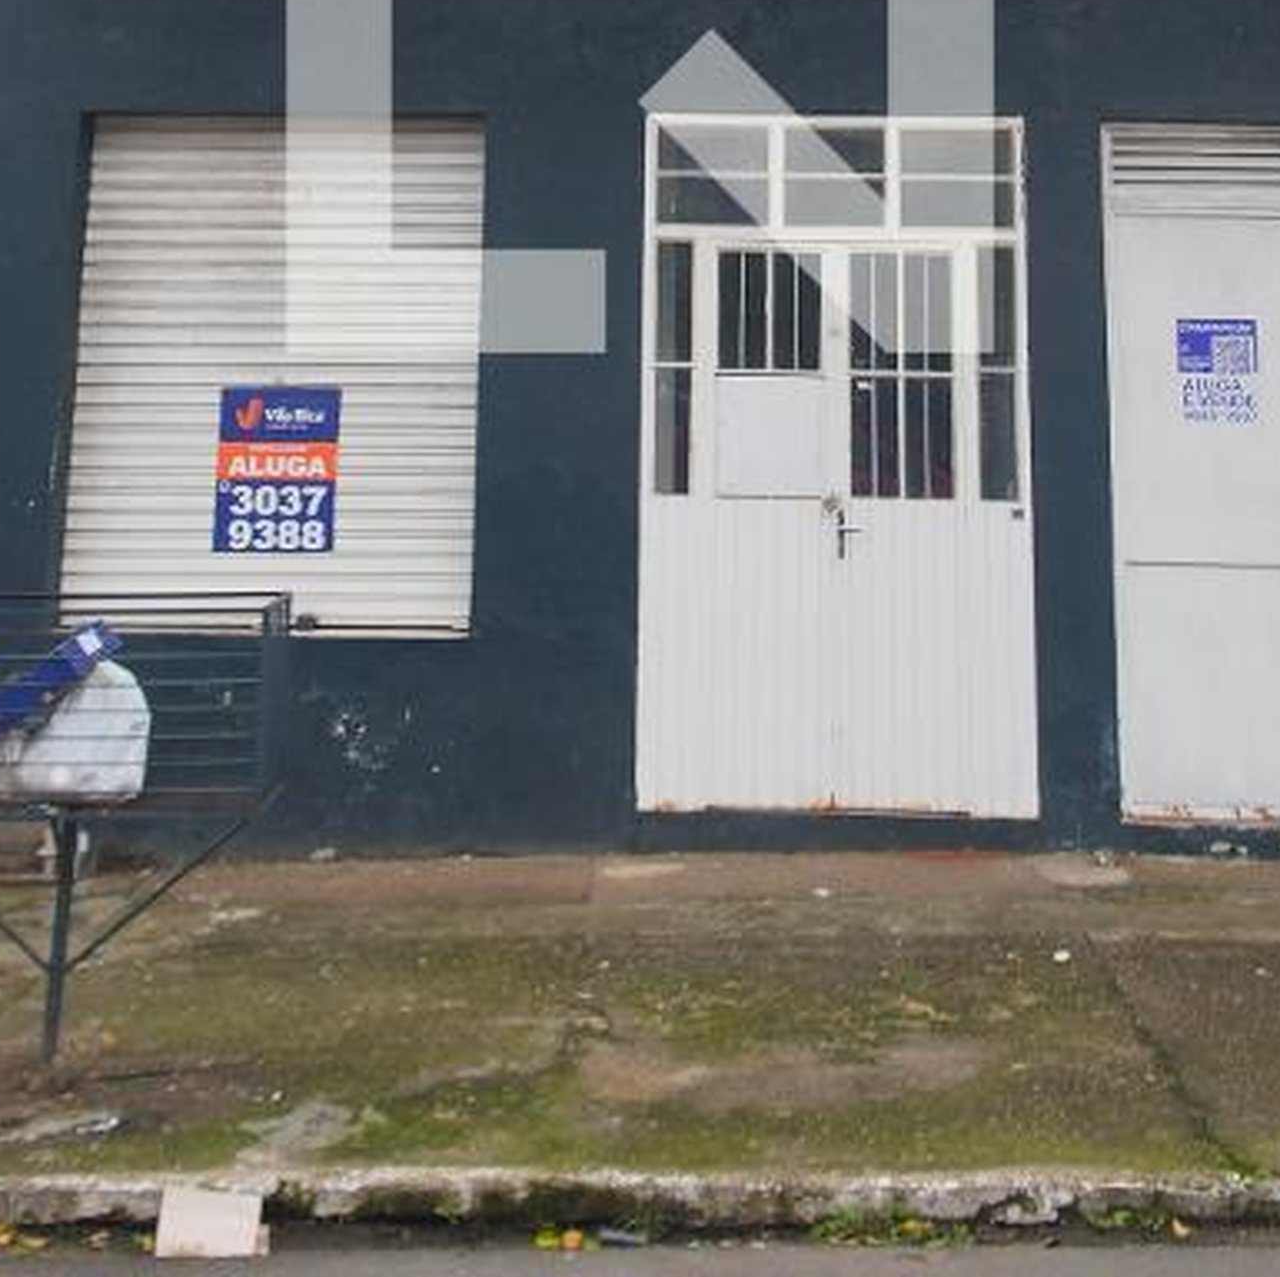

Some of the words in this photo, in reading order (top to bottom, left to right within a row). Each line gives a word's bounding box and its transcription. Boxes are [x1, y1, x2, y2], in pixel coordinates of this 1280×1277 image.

[229, 456, 326, 478] ALUGA
[229, 485, 328, 516] 3037
[228, 519, 326, 550] 9388
